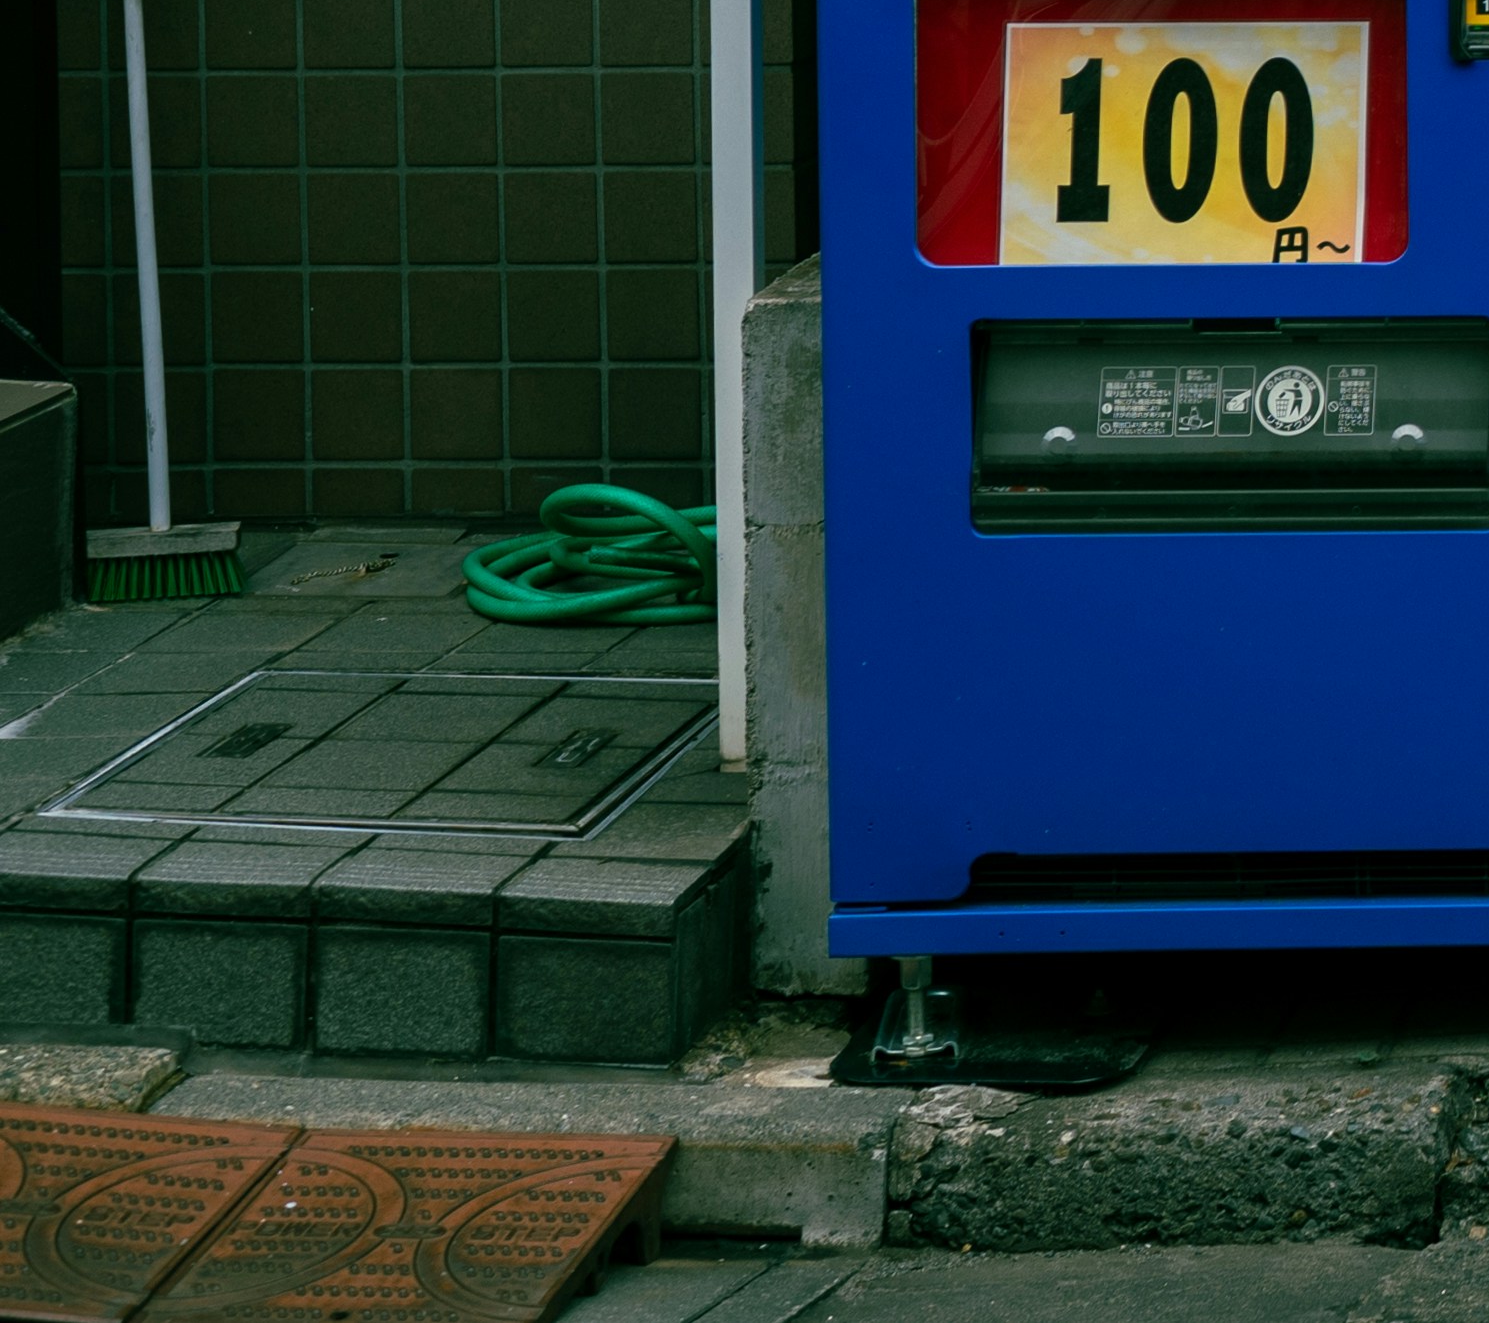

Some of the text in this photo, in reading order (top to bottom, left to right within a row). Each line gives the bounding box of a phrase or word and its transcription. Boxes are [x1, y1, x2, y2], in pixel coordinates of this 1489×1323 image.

[1055, 56, 1315, 224] 100
[1265, 414, 1315, 434] リサイクル
